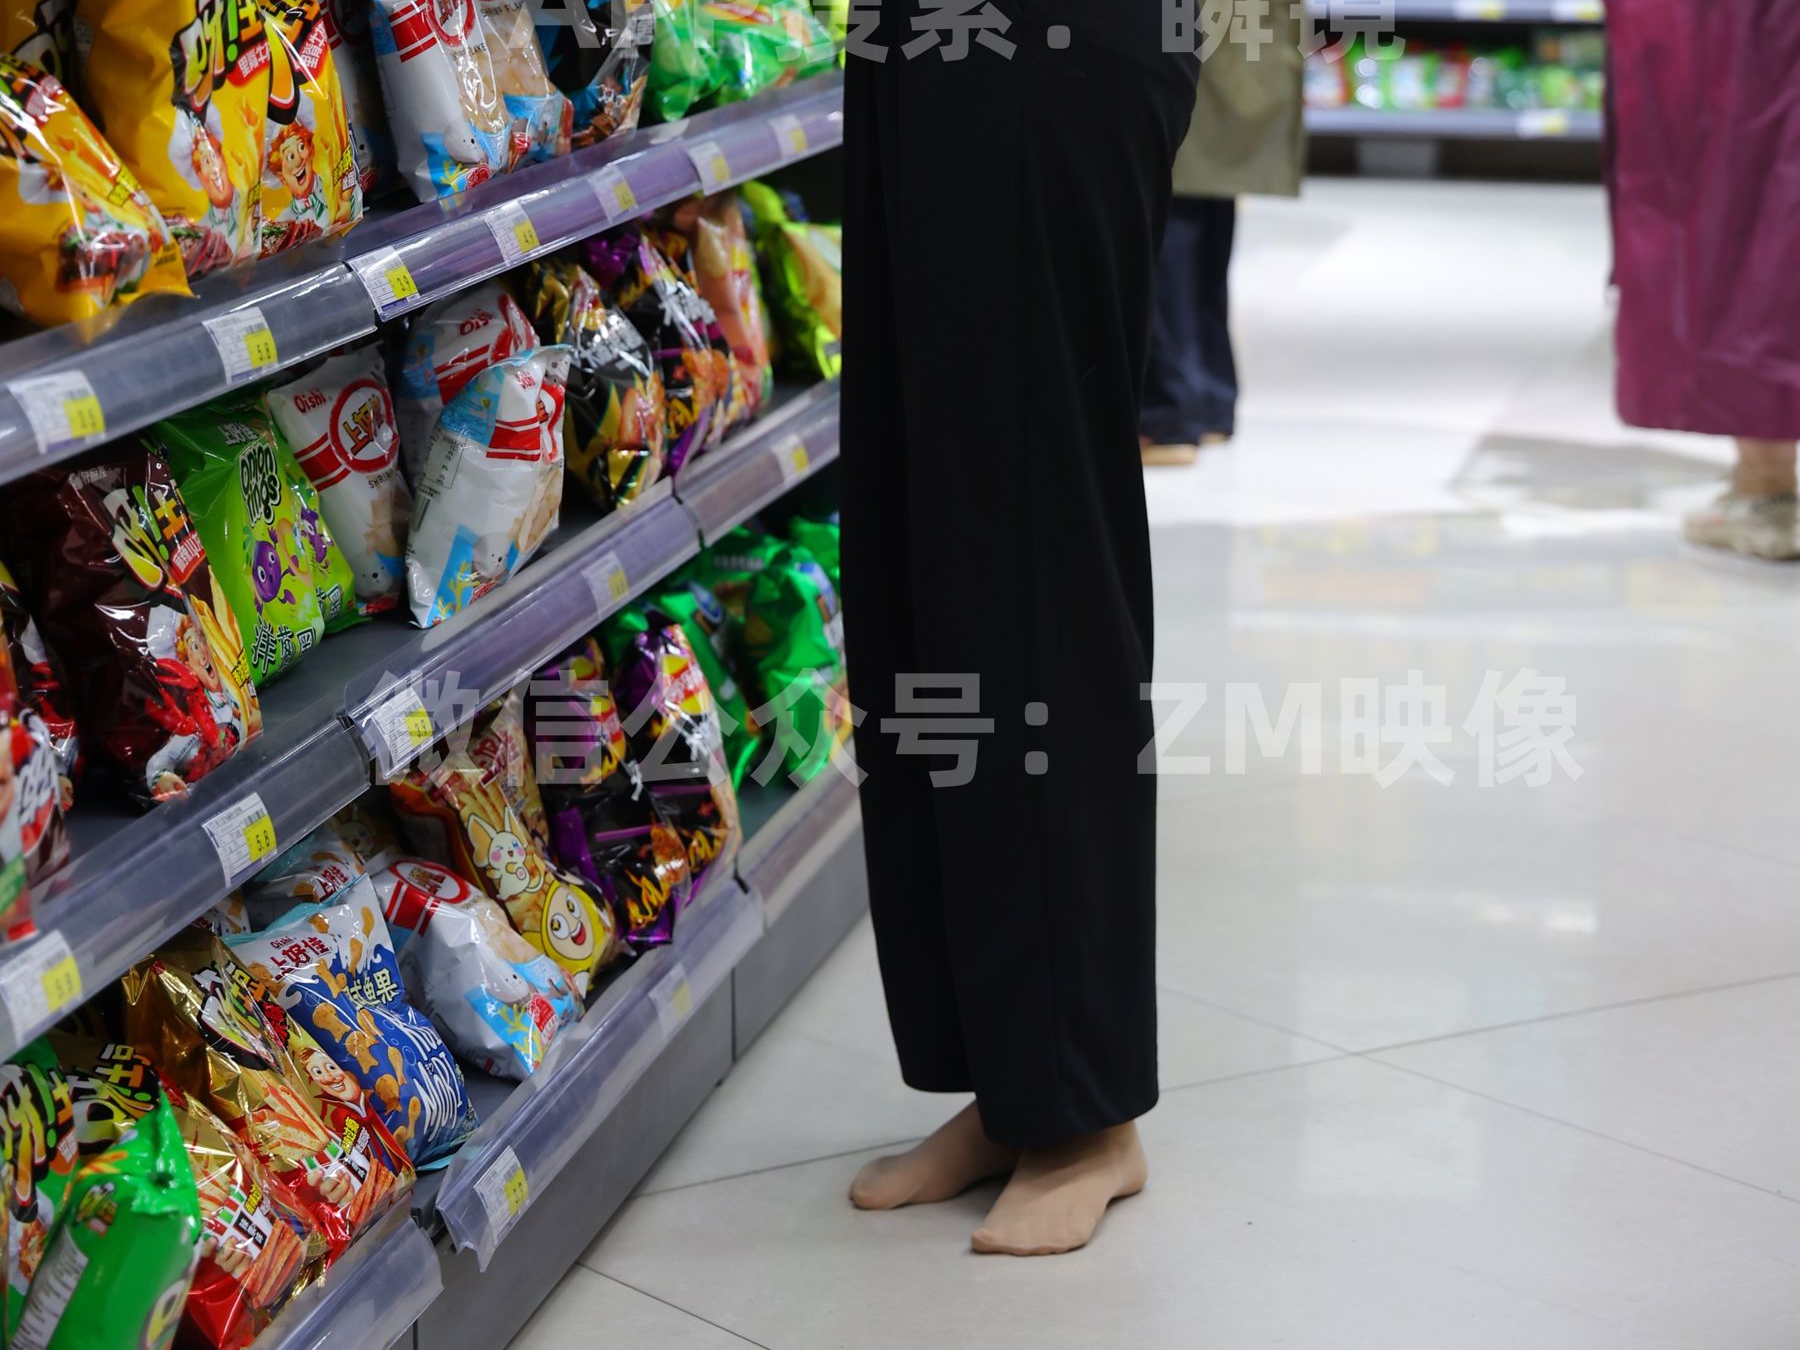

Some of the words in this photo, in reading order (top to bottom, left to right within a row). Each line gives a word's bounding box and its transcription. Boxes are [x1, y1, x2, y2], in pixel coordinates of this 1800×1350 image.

[294, 390, 326, 414] Oishi
[255, 829, 271, 852] 5.8
[270, 935, 294, 949] Oishi
